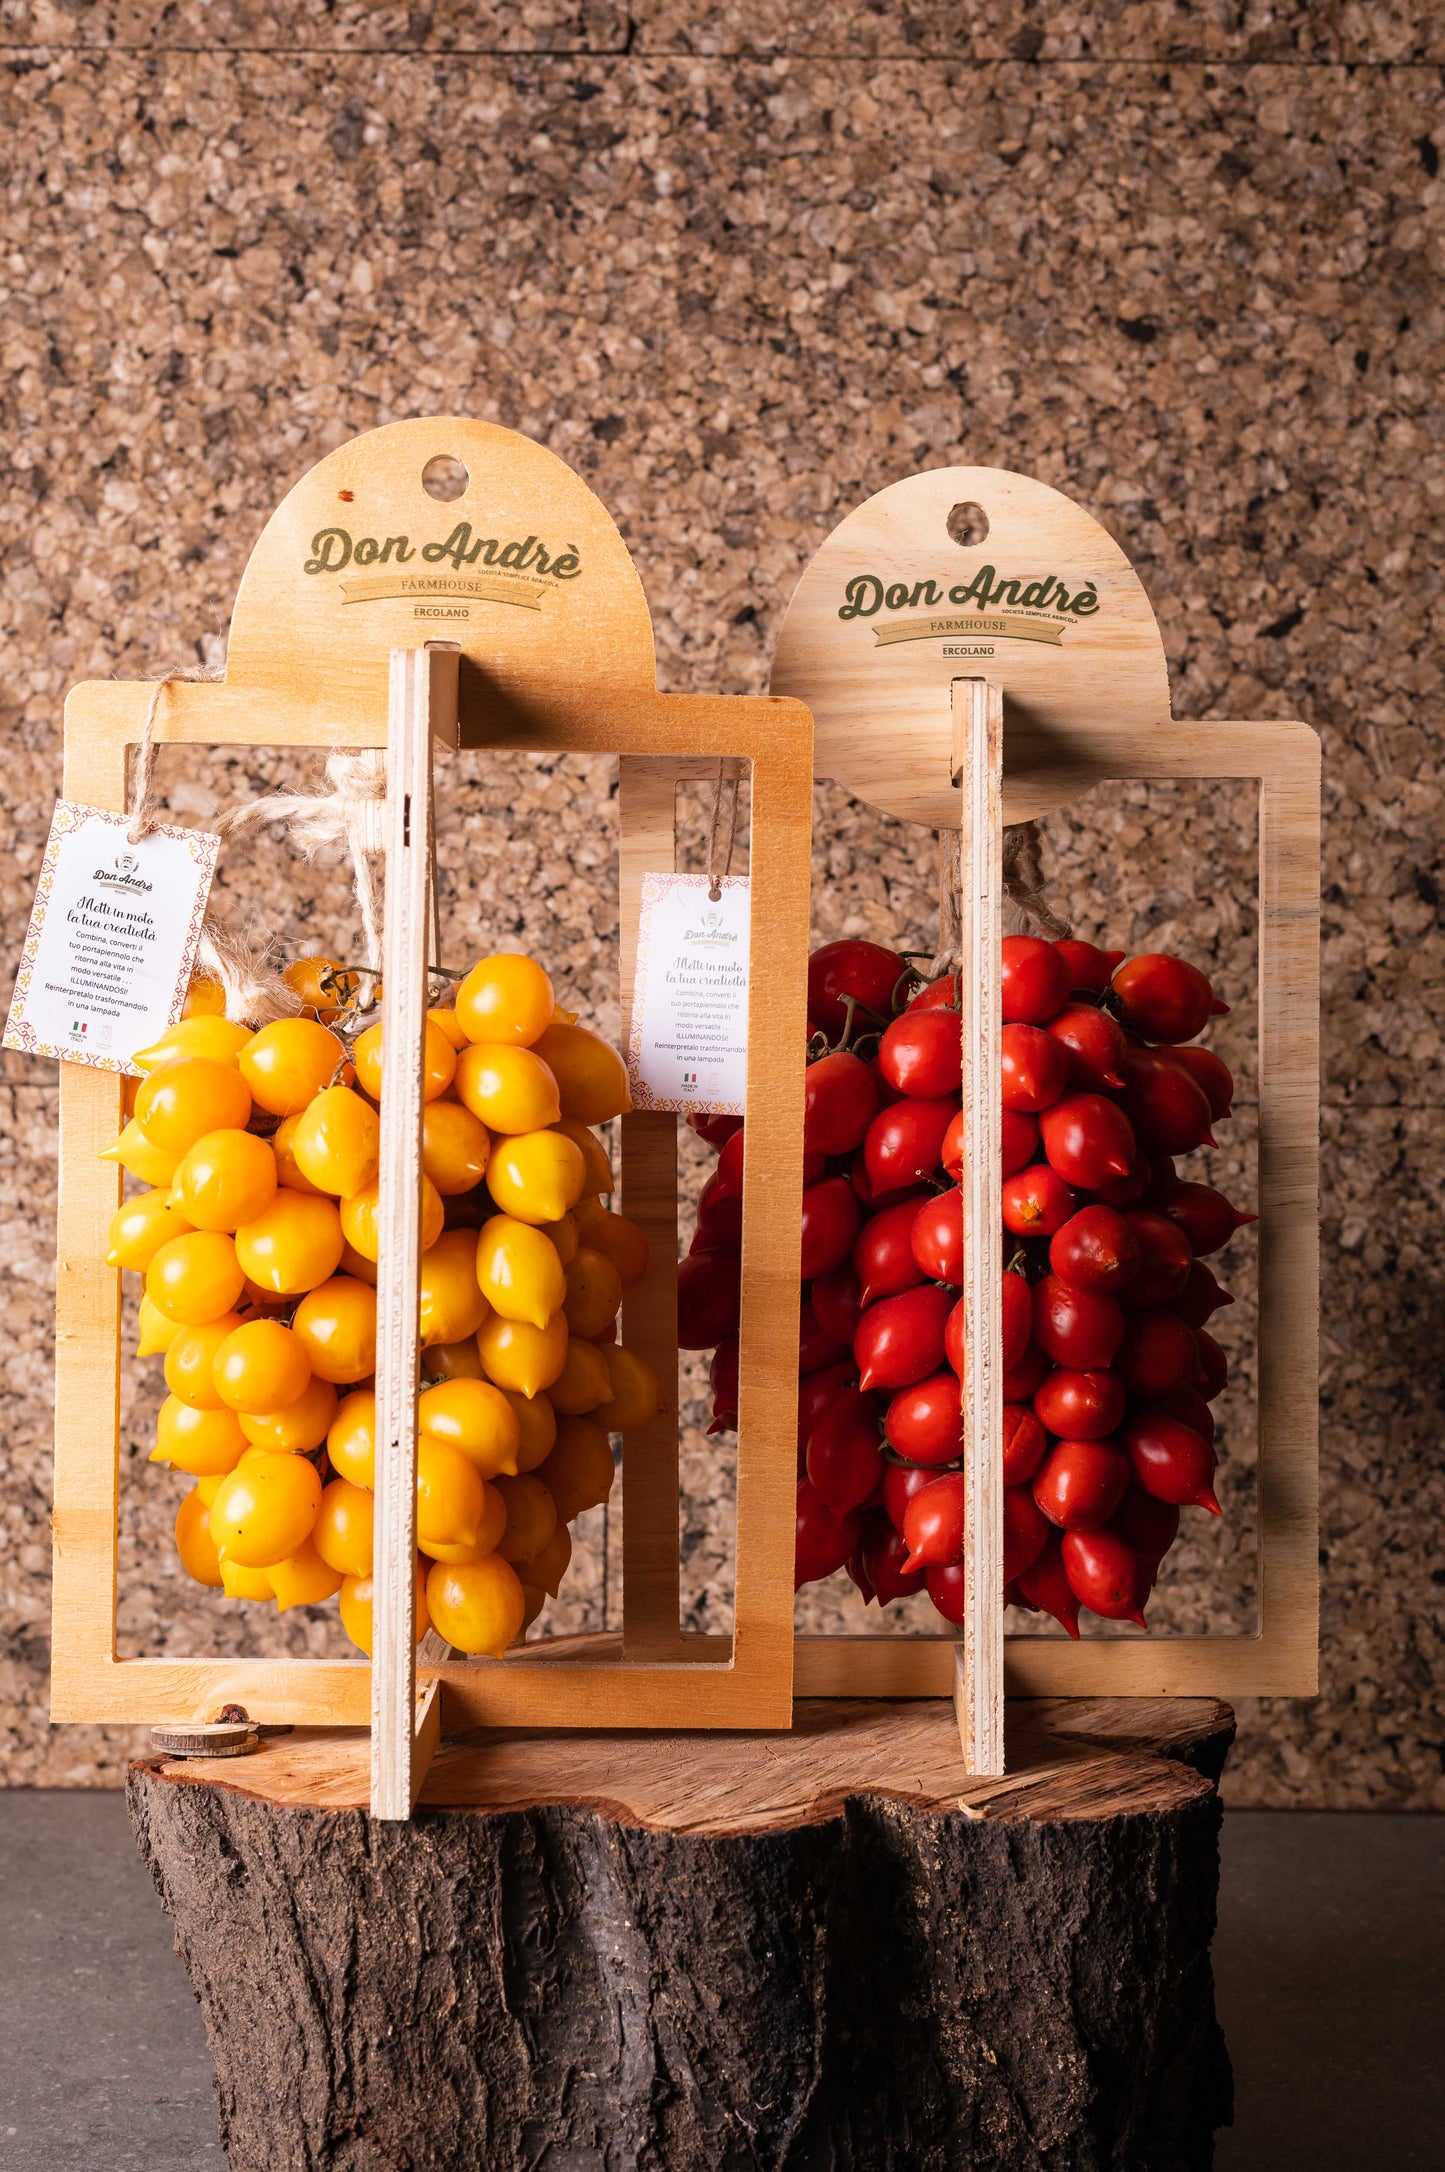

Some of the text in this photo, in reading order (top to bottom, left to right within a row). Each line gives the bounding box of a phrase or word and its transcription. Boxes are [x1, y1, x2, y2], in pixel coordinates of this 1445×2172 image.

[303, 521, 582, 580] Don Andrè
[401, 579, 483, 593] FARMHOUSE
[503, 571, 531, 581] SEMPLICE
[531, 577, 559, 588] AGRICOLA
[838, 564, 1101, 621] Don Andrè
[414, 607, 469, 618] ERCOLANO
[1001, 608, 1078, 624] SOCIETÀ SEMPLICE AGRICOLA
[930, 619, 1007, 632] FARMHOUSE
[942, 646, 995, 656] ERCOLANO
[92, 869, 118, 881] Don
[118, 874, 153, 892] Andrè
[76, 896, 154, 926] Metti in moto
[66, 909, 158, 942] la tua creatività
[75, 930, 108, 944] Combina,
[109, 939, 138, 951] converti
[683, 929, 705, 940] Don
[69, 941, 145, 965] tuo portapiennolo che
[74, 954, 98, 966] ritorna
[99, 960, 112, 968] alla
[112, 963, 126, 972] vita
[672, 956, 743, 973] Metti in moto
[70, 966, 91, 976] modo
[92, 970, 122, 983] versatile
[665, 970, 677, 984] la
[677, 972, 697, 985] tua
[44, 982, 149, 1012] Reinterpretalo trasformandolo
[675, 989, 705, 999] Combina,
[67, 999, 121, 1018] in una lampada
[682, 1000, 727, 1010] portapiennolo
[727, 1002, 740, 1010] che
[68, 1031, 82, 1039] MADE
[694, 1023, 721, 1031] versatile
[654, 1042, 699, 1051] Reinterpretalo
[697, 1055, 725, 1064] lampada
